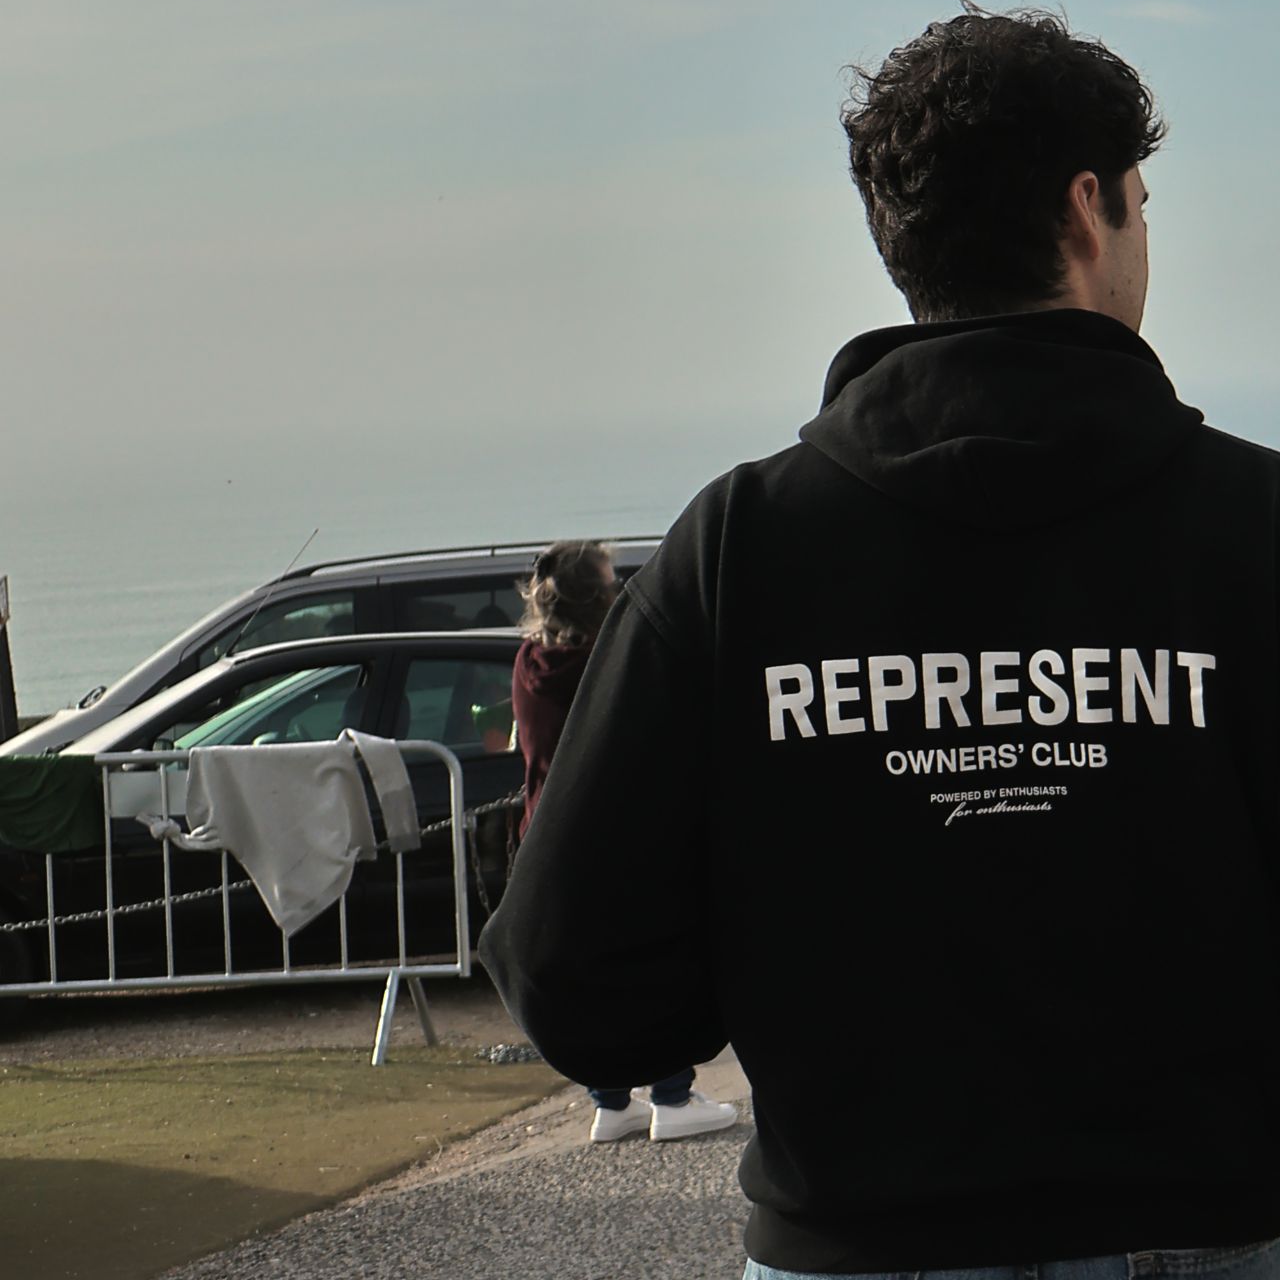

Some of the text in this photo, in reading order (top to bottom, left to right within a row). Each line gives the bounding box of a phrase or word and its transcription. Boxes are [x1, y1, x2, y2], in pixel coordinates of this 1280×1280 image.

[765, 648, 1216, 741] REPRESENT
[886, 742, 1107, 775] OWNERS' CLUB
[930, 786, 1068, 803] POWERED BY ENTHUSIASTS
[944, 800, 1053, 826] for enthusiasts
